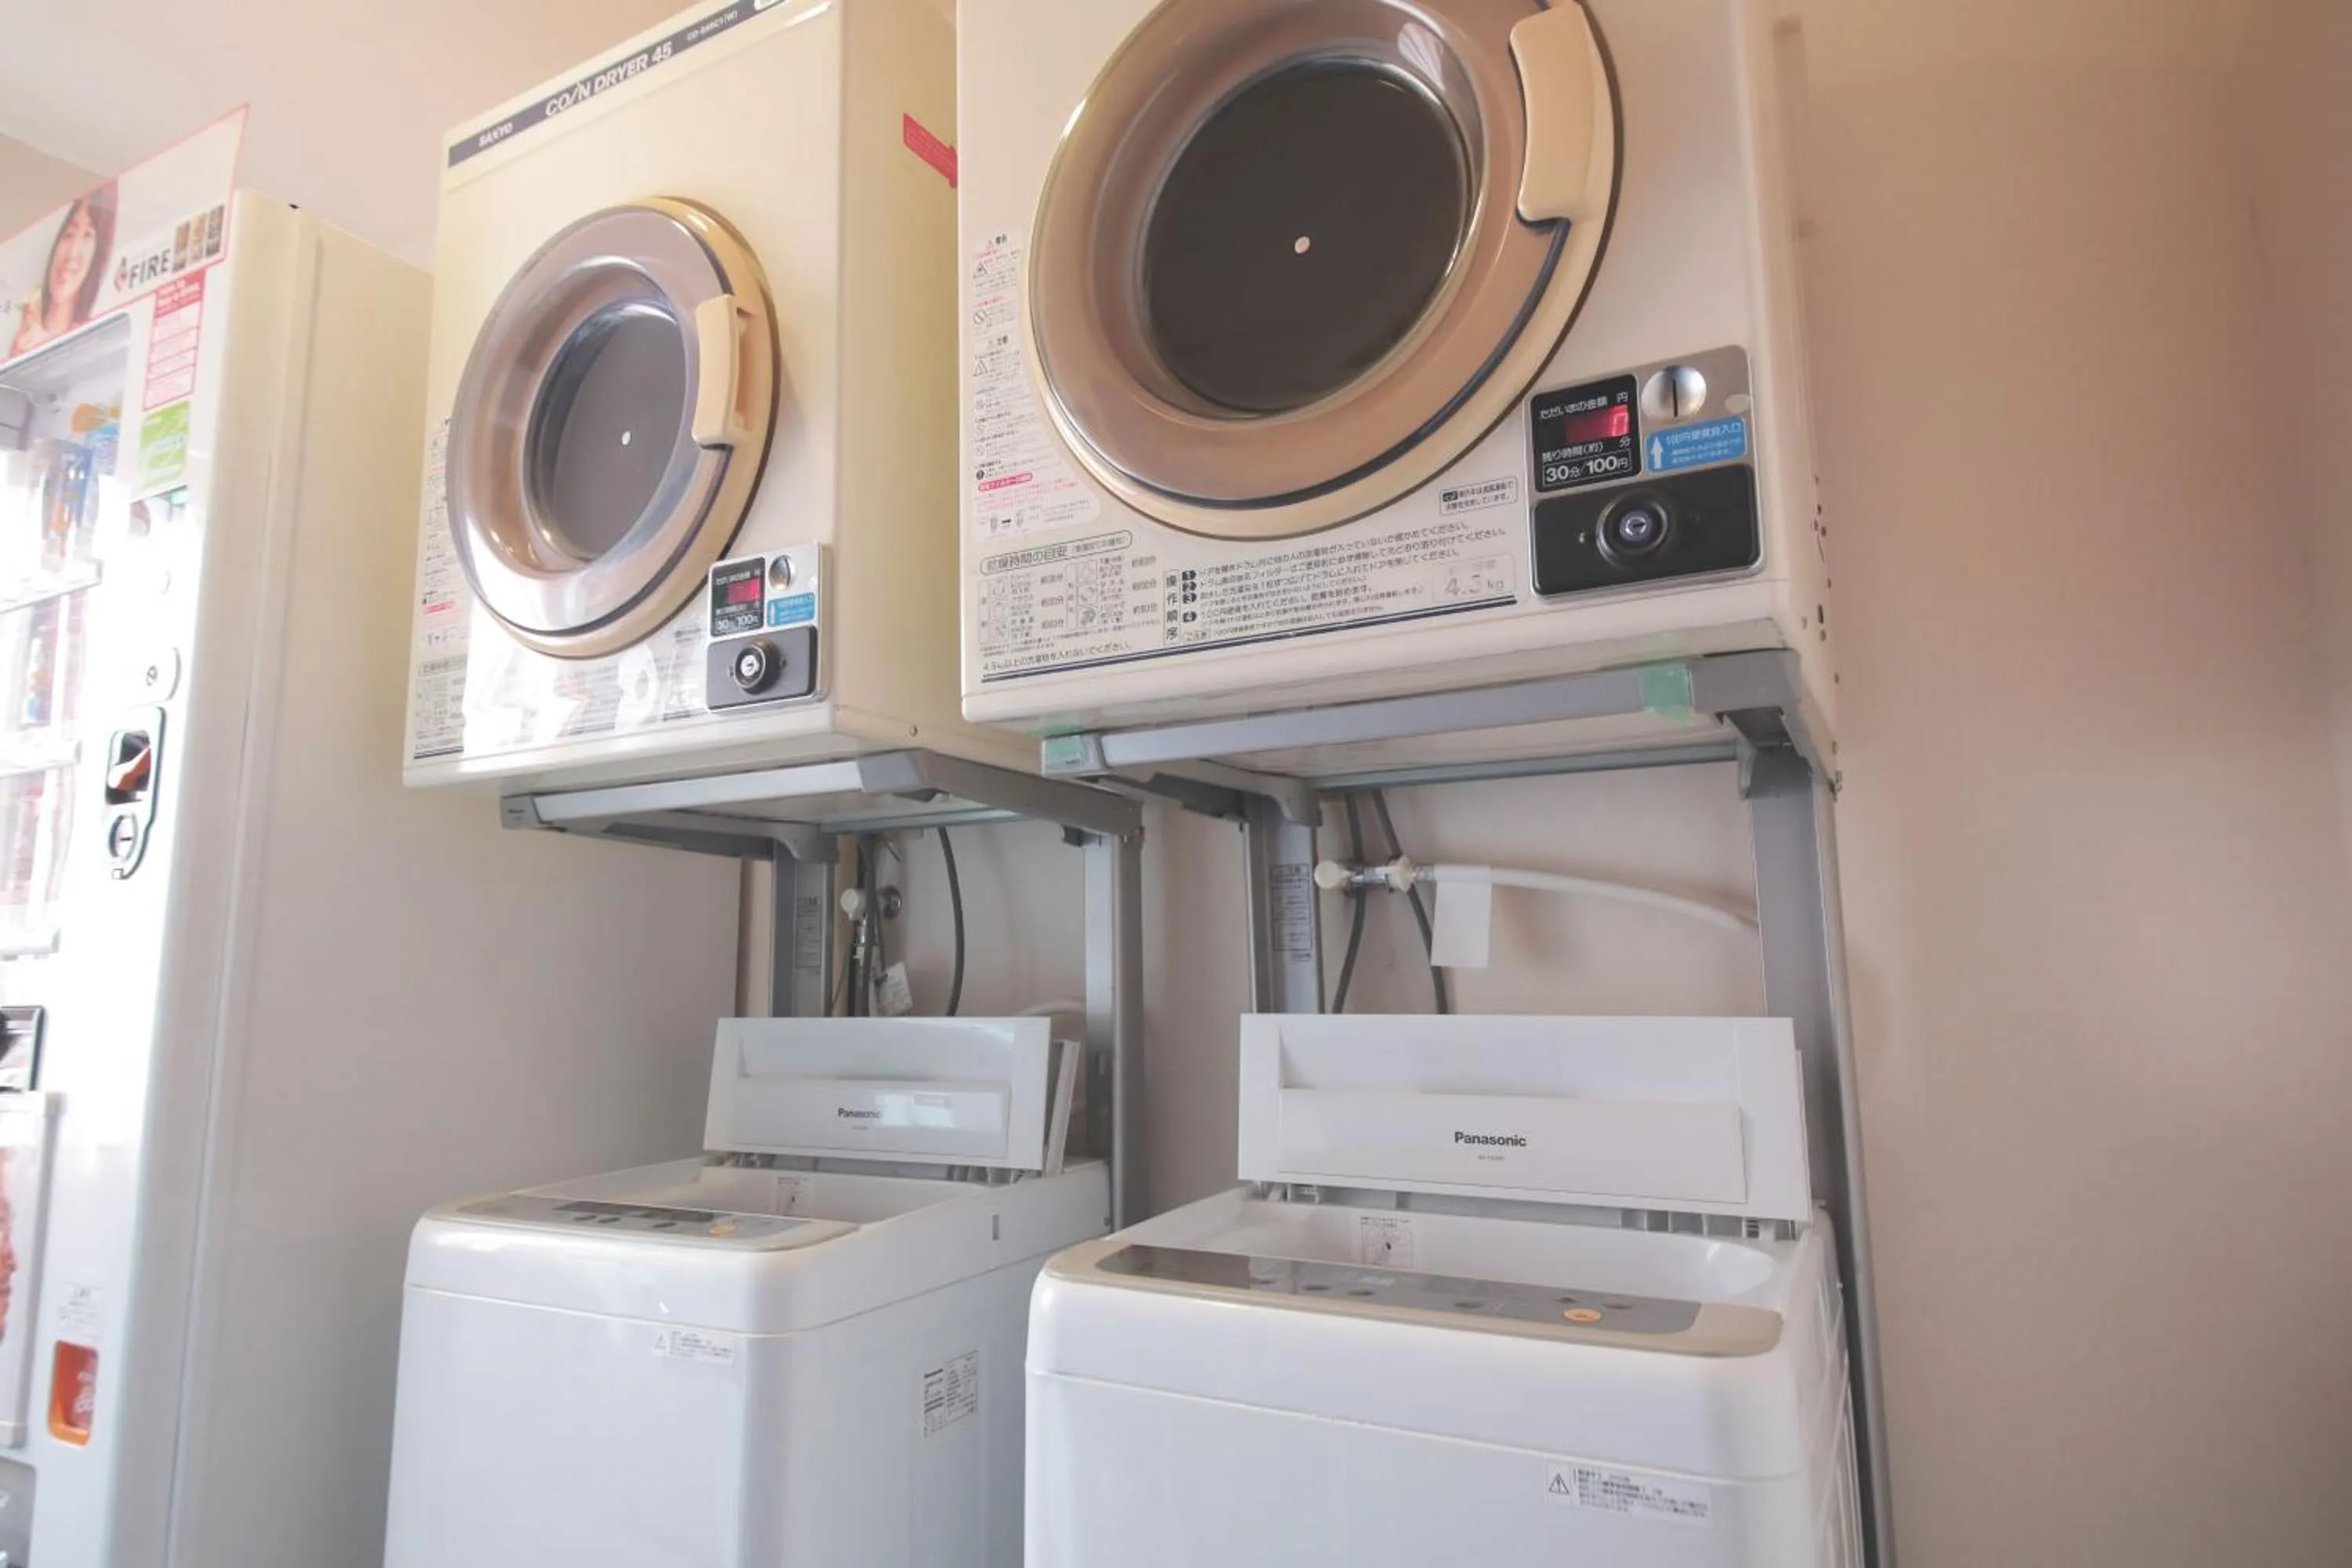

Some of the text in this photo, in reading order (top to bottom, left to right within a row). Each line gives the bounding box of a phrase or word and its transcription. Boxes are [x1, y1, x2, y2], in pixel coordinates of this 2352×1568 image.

[593, 53, 648, 93] DRYER
[652, 41, 673, 63] 45
[478, 122, 514, 147] SANYO
[129, 248, 170, 289] FIRE
[1487, 578, 1504, 590] kg
[838, 1107, 882, 1119] Panasonic
[1454, 1131, 1527, 1147] Panasonic
